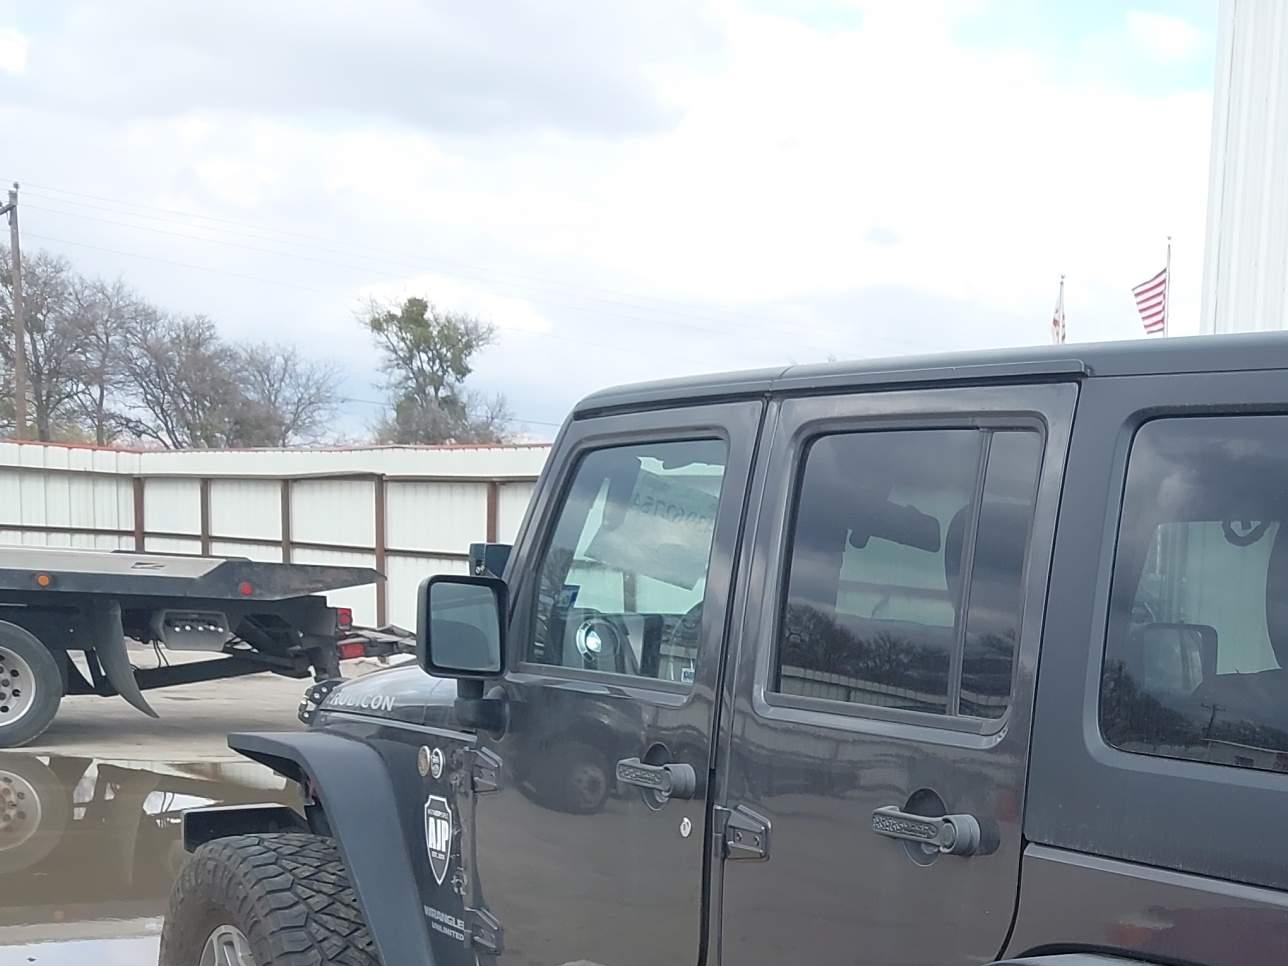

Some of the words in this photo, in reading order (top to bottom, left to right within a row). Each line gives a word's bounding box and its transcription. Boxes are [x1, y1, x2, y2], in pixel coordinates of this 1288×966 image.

[329, 693, 396, 712] RUBICON
[428, 816, 449, 853] AJP
[424, 905, 465, 930] WRANGLE
